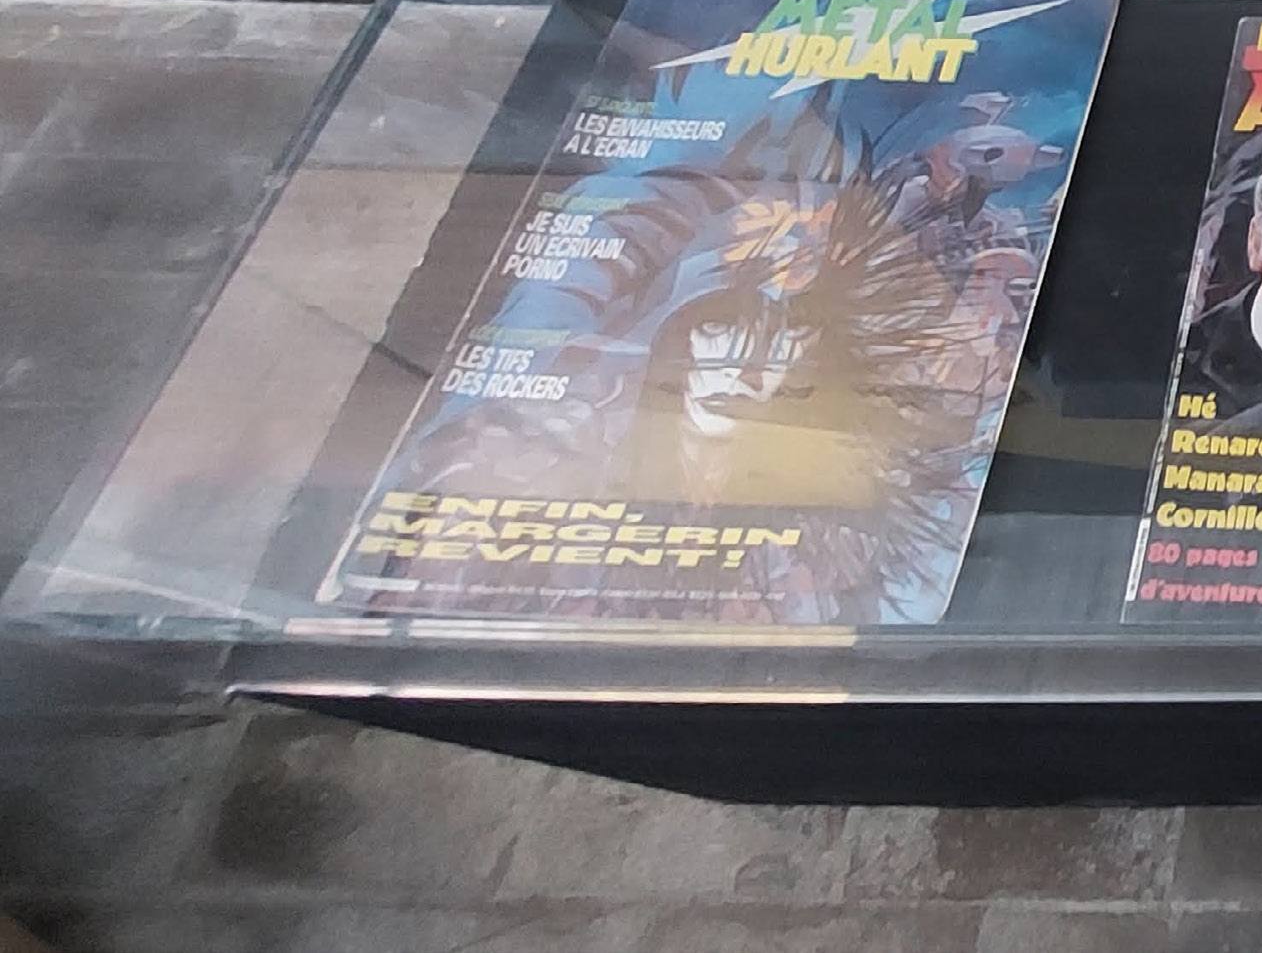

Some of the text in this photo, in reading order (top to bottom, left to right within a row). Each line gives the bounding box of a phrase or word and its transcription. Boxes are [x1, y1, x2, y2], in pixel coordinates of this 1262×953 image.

[725, 32, 978, 83] HURLANT
[574, 112, 726, 141] LES ENVAHISSEURS
[562, 133, 580, 153] A
[526, 210, 594, 236] JE SUIS
[515, 231, 627, 261] UN ECRIVAIN
[501, 254, 568, 281] PORNO
[455, 343, 535, 373] LES TIFS
[441, 367, 570, 401] DES ROCKERS
[1178, 392, 1217, 420] Hé
[379, 492, 645, 522] ENFIN,
[367, 512, 801, 545] MARGERIN
[1147, 542, 1258, 568] 80 pages
